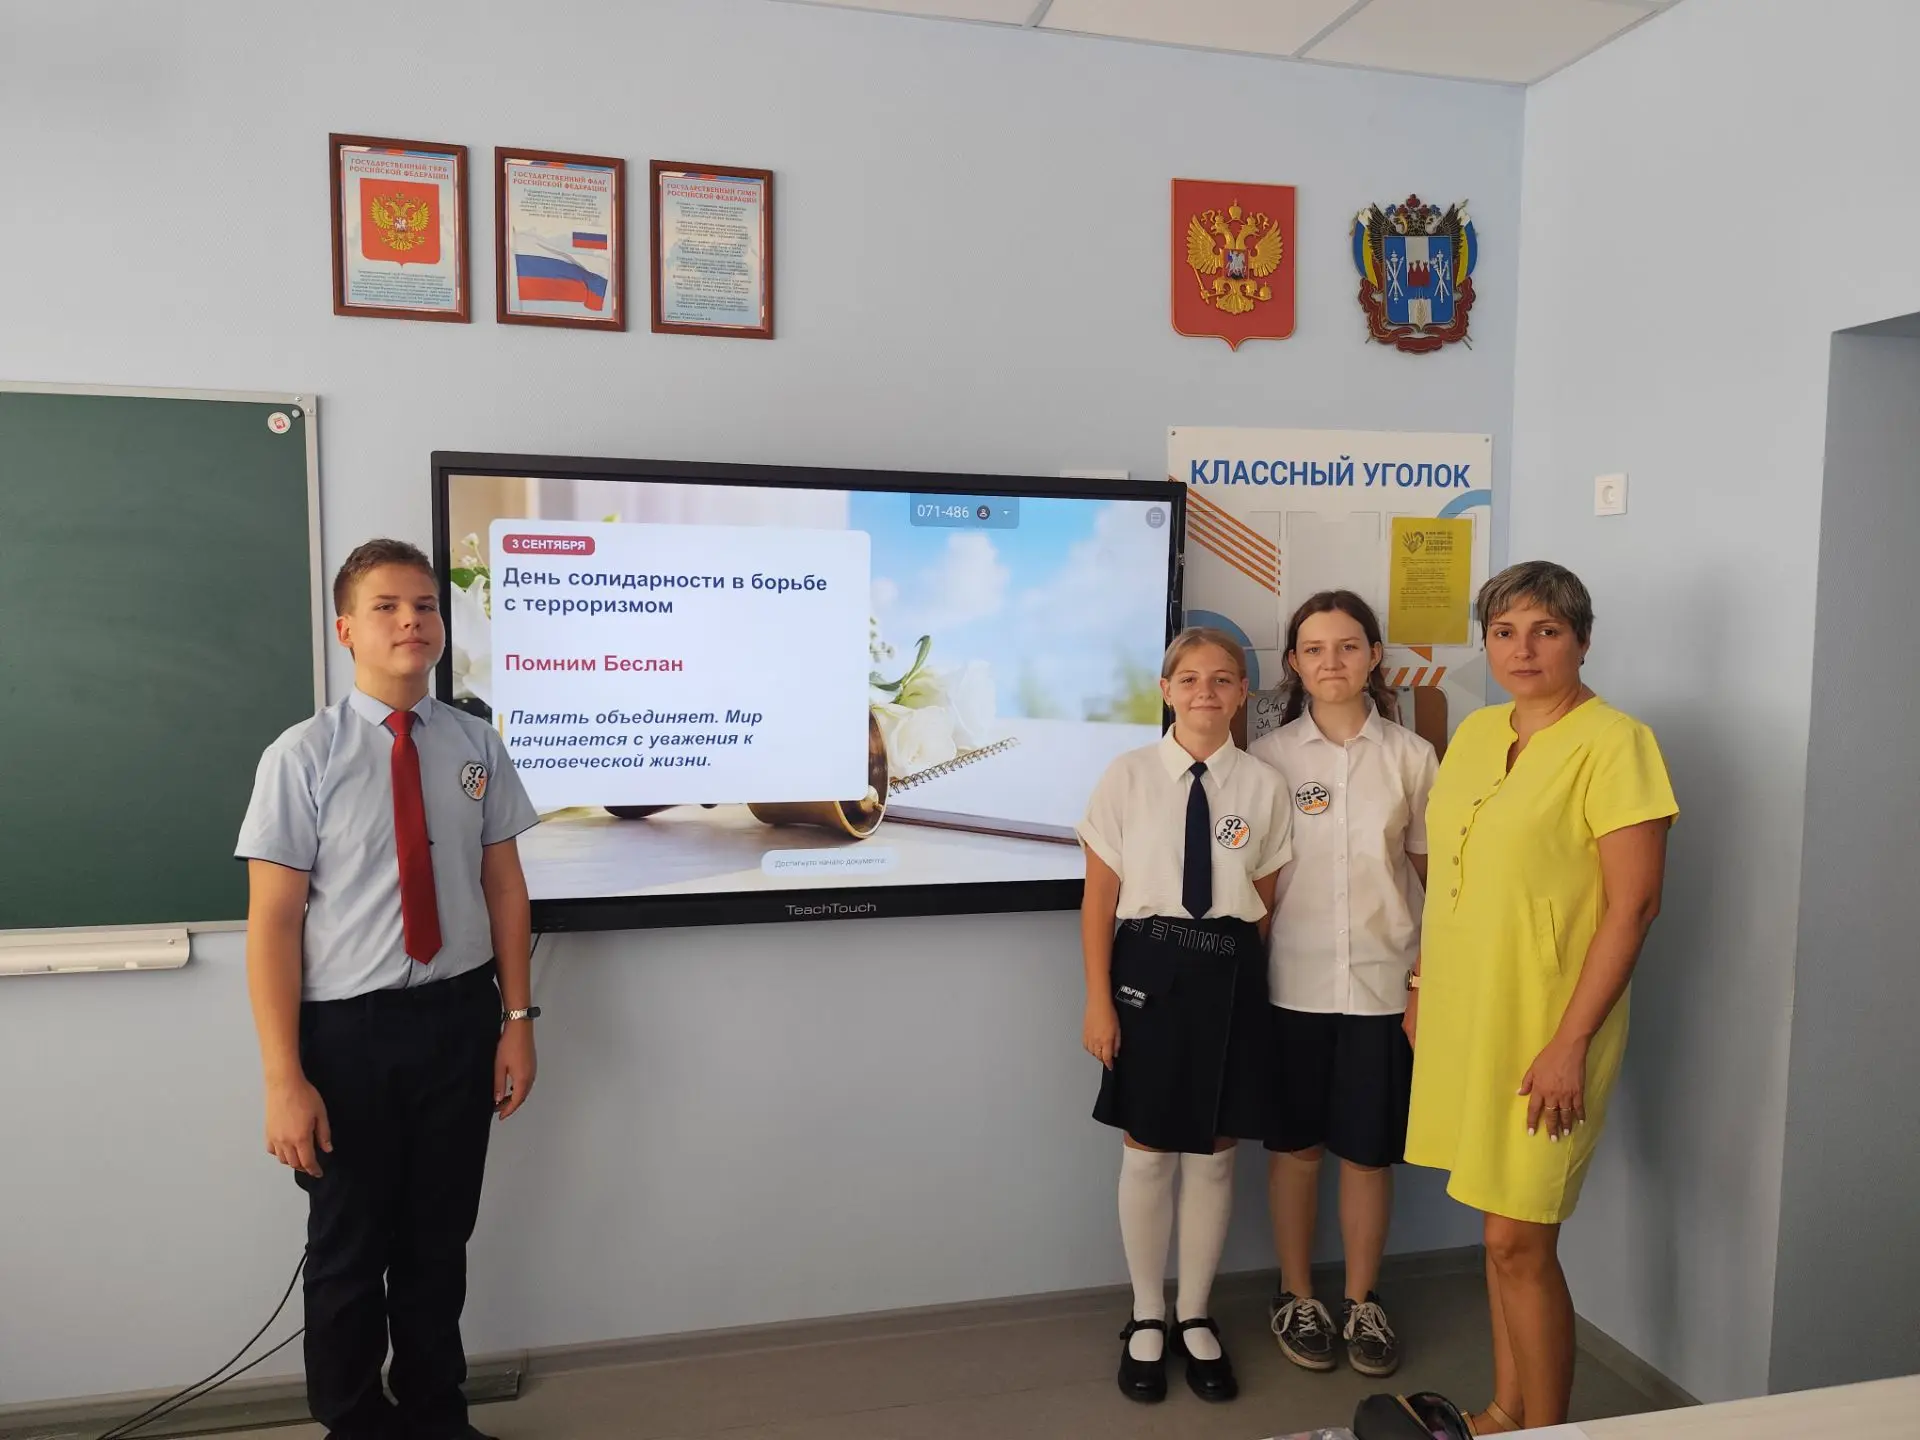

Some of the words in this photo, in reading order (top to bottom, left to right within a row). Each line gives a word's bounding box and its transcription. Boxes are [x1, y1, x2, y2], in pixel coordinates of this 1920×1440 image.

[1191, 455, 1354, 486] КЛАССНЫЙ
[1363, 463, 1471, 488] УГОЛОК
[917, 504, 970, 519] 071-486
[512, 539, 519, 549] 3
[522, 539, 586, 551] СЕНТЯБРЯ
[503, 567, 561, 588] День
[568, 571, 725, 592] солидарности
[732, 577, 744, 589] в
[751, 573, 828, 594] борьбе
[504, 597, 516, 612] с
[524, 597, 673, 616] терроризмом
[505, 654, 597, 671] Помним
[604, 655, 684, 672] Беслан
[510, 710, 589, 725] Память
[595, 709, 719, 725] объединяет.
[725, 710, 763, 726] Мир
[510, 734, 628, 747] начинается
[633, 735, 644, 746] с
[649, 733, 739, 749] уважения
[743, 732, 753, 745] к
[512, 753, 645, 769] человеческой
[649, 756, 712, 768] жизни.
[469, 766, 485, 778] 92
[1311, 786, 1327, 802] 92
[1225, 819, 1242, 830] 92
[775, 859, 817, 868] Достигнуто
[785, 902, 877, 916] TeachTouch
[1150, 919, 1236, 956] SMILE
